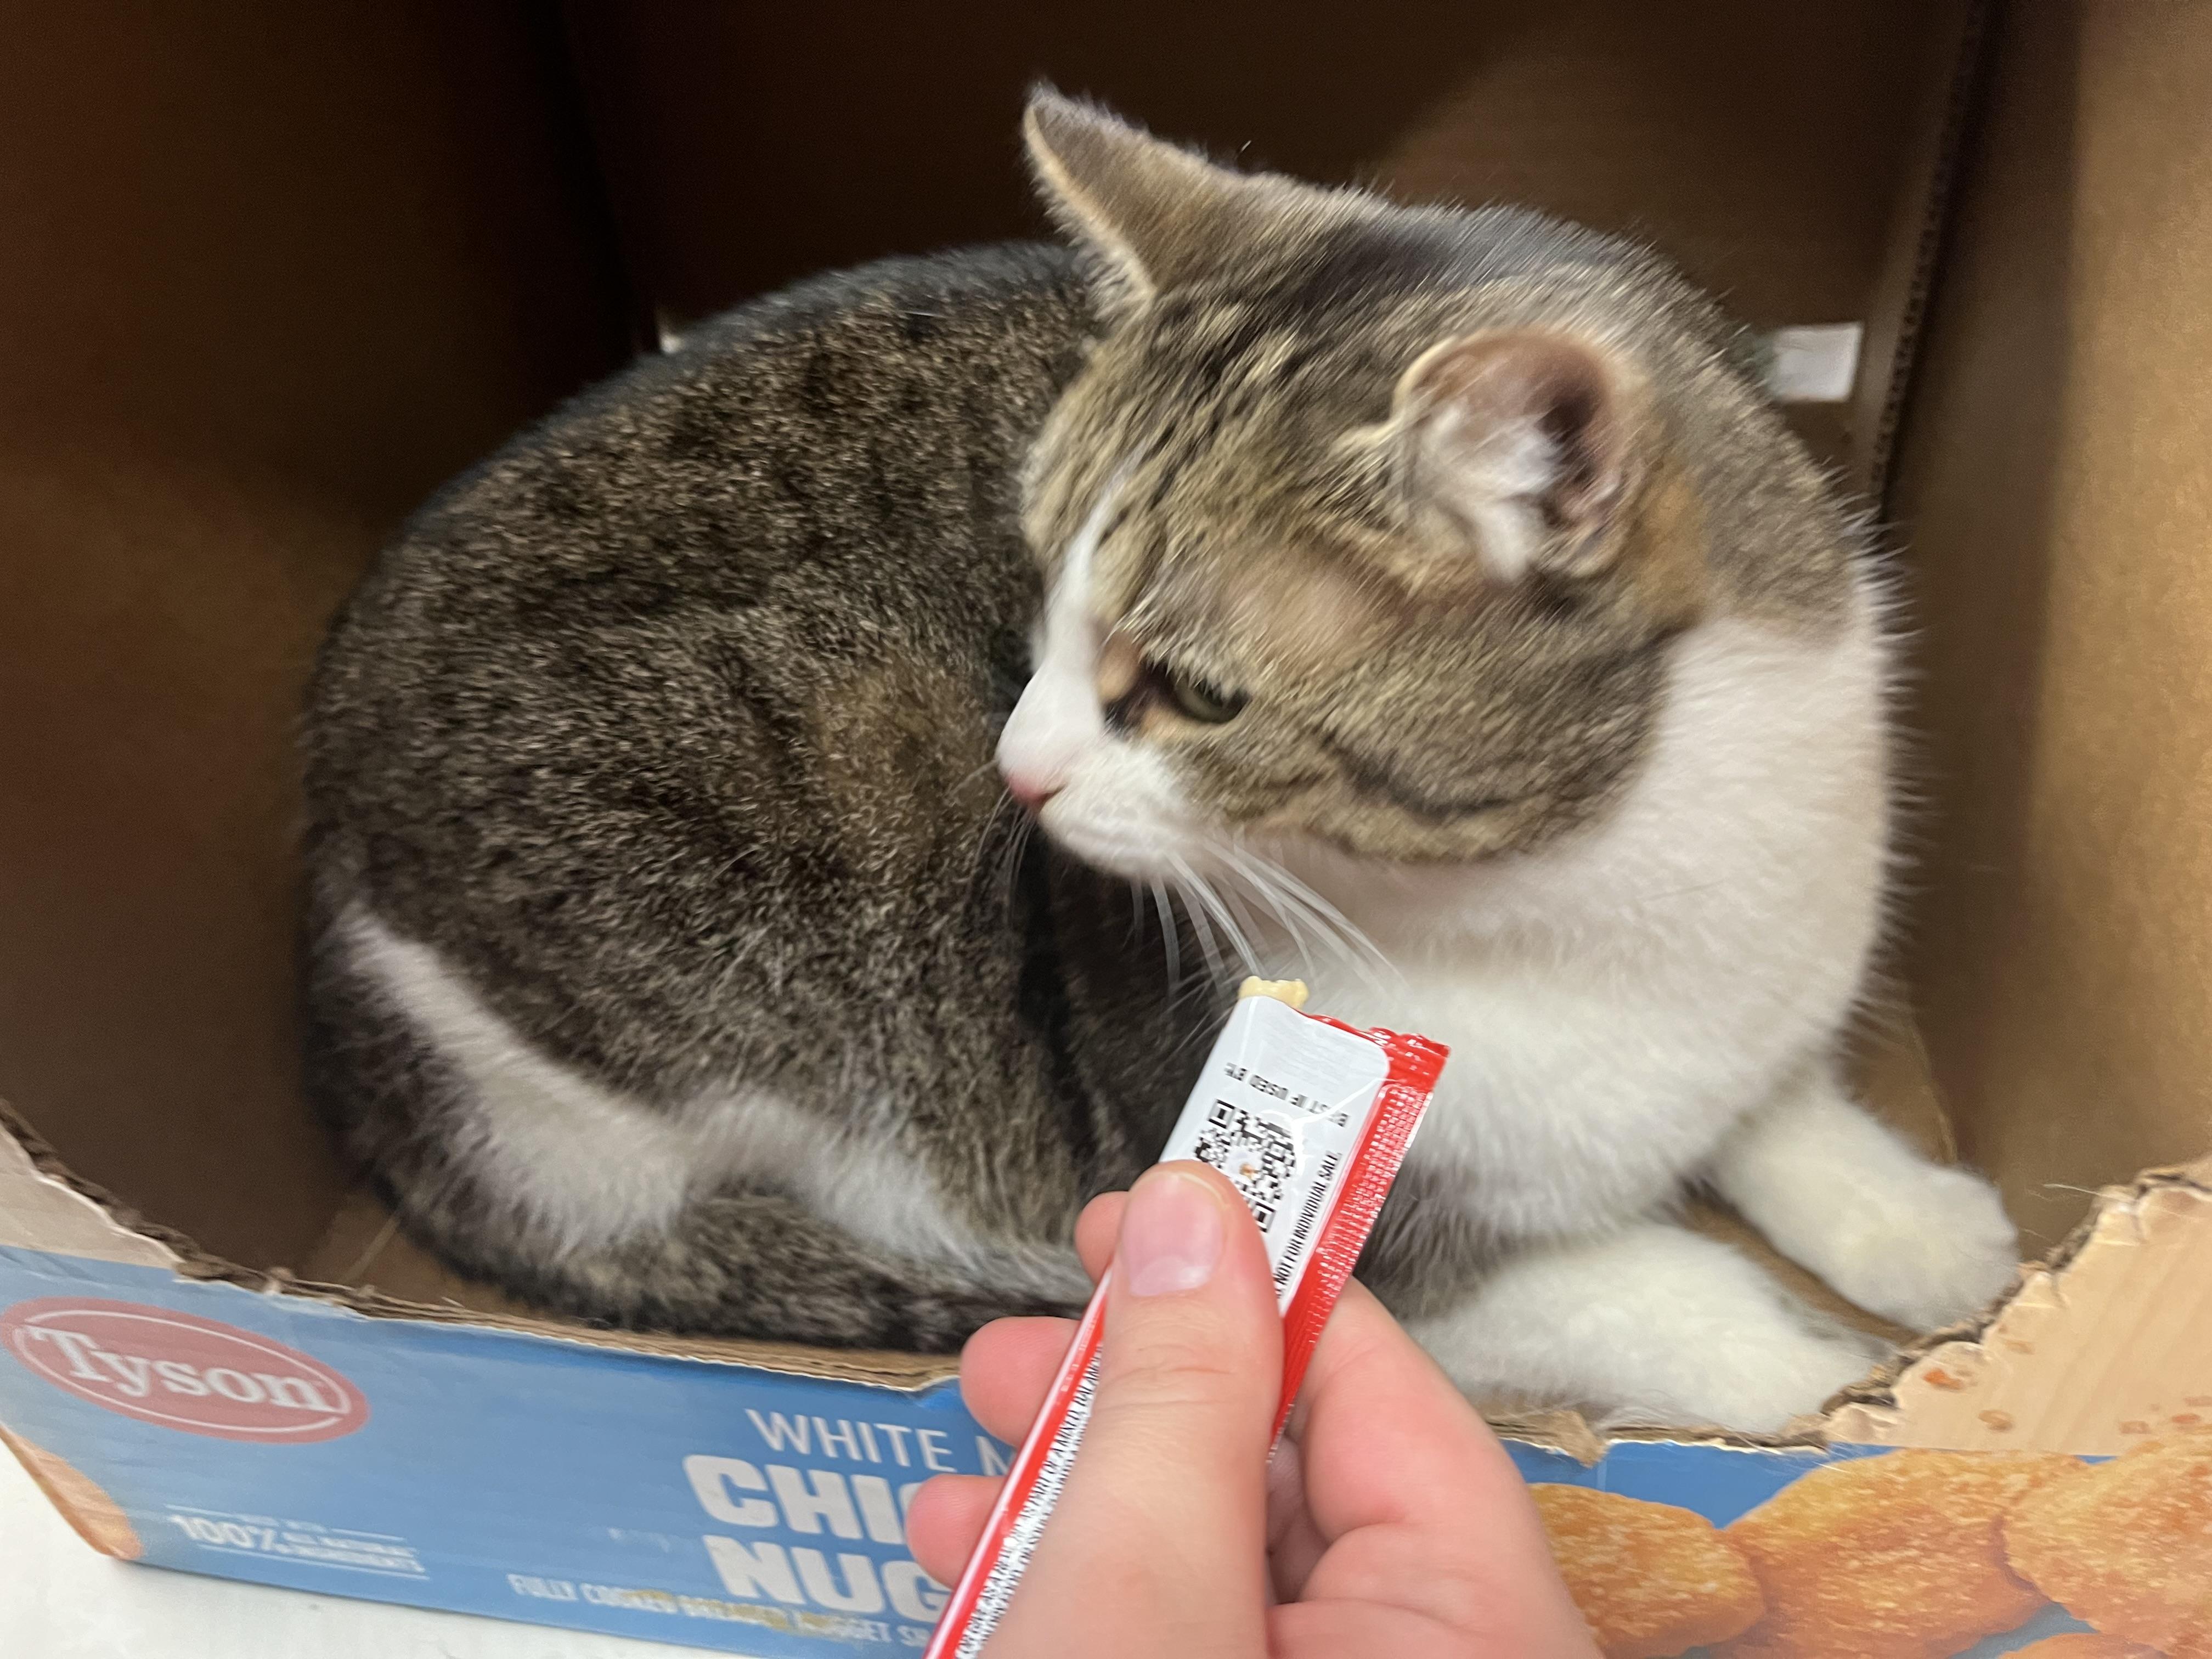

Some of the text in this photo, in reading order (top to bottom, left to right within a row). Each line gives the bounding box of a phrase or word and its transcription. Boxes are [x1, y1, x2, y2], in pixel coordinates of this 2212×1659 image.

[1249, 1074, 1289, 1101] USED
[1290, 1093, 1308, 1108] IF
[1292, 1181, 1330, 1240] INDIVIDUAL
[1283, 1238, 1304, 1262] FOR
[1273, 1261, 1294, 1285] NOT
[25, 1326, 342, 1414] Tyson
[744, 1408, 958, 1474] WHITE
[682, 1454, 924, 1545] CHI
[168, 1514, 291, 1555] 100%
[506, 1573, 578, 1601] FULLY
